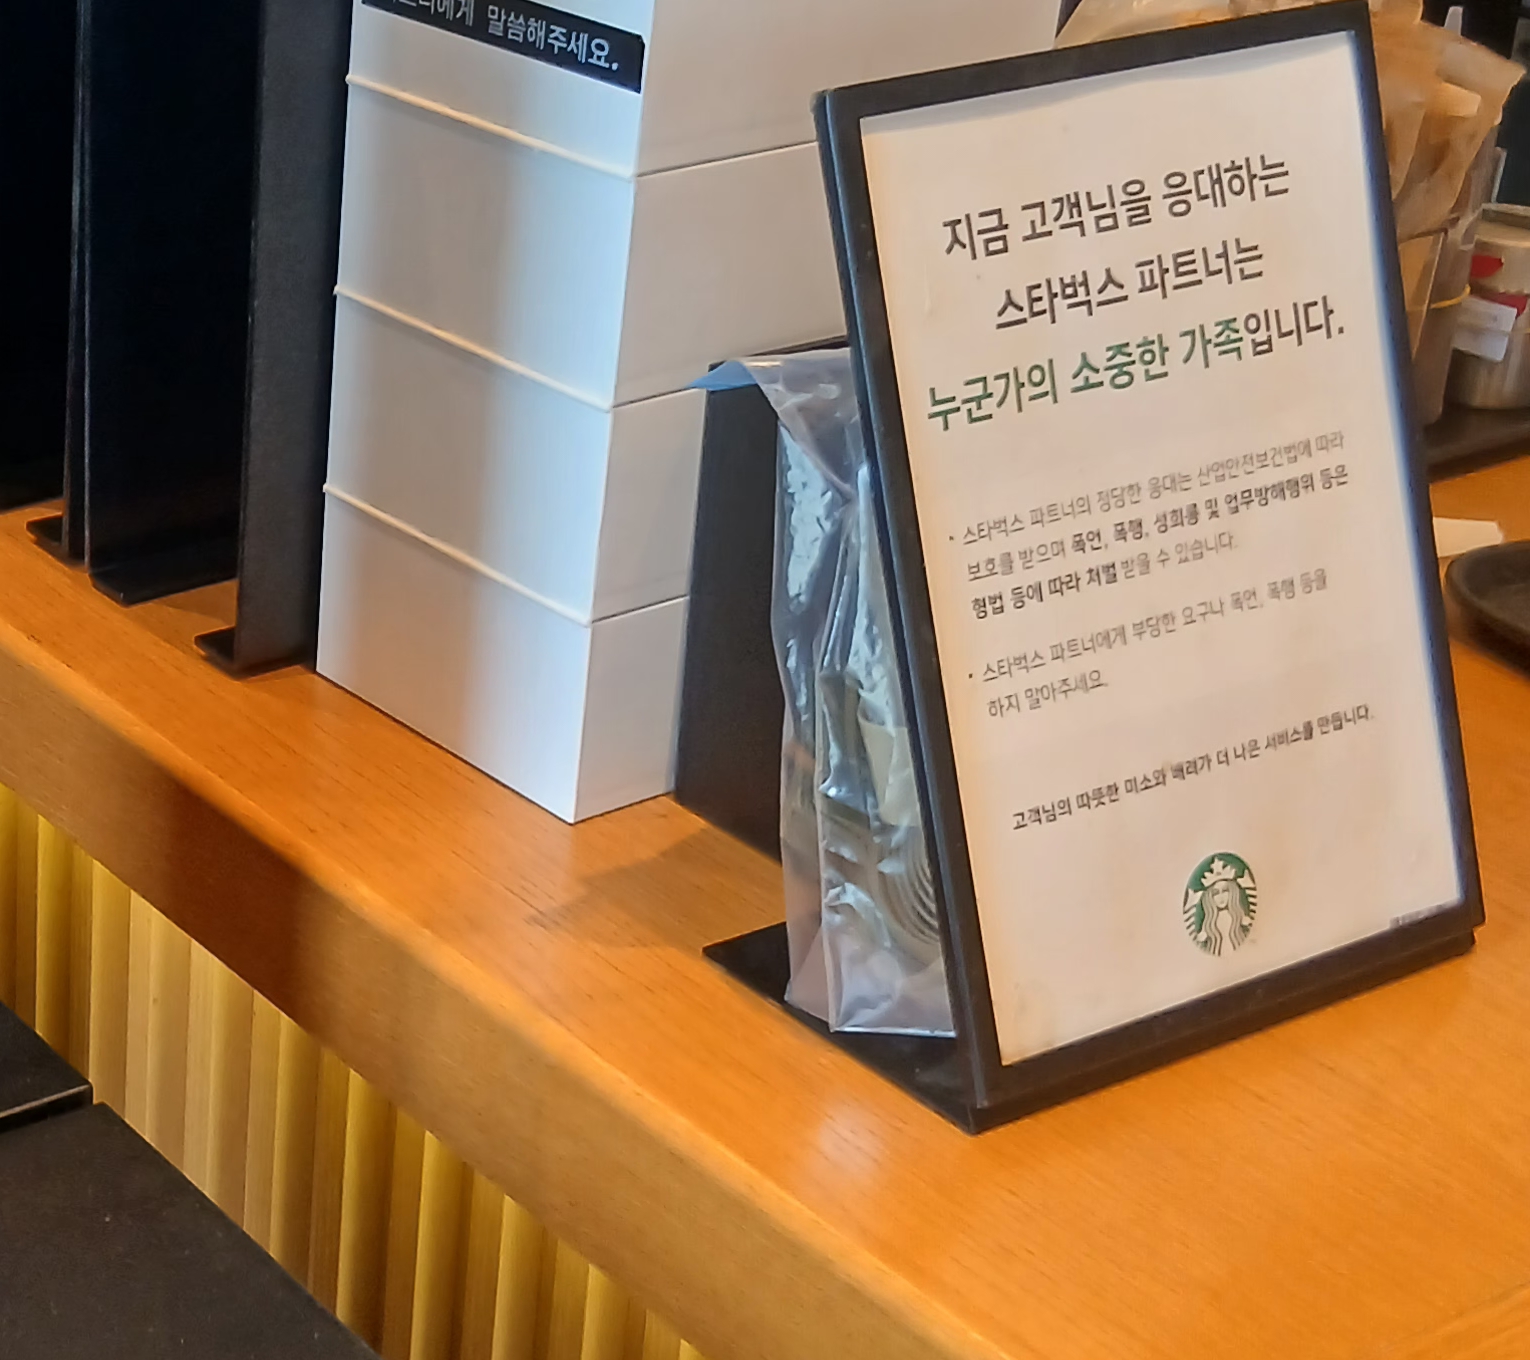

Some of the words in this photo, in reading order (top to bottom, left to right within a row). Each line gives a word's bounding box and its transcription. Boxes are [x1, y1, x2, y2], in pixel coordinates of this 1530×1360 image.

[487, 4, 620, 72] 말씀해주세요.
[942, 207, 1011, 261] 지금
[1020, 177, 1153, 244] 고객님을
[1162, 153, 1291, 218] 응대하는
[995, 265, 1129, 331] 스타벅스
[1135, 237, 1265, 301] 파트너는
[927, 357, 1058, 431] 누군가의
[1070, 335, 1171, 394] 소중한
[1179, 295, 1345, 370] 가족입니다.
[962, 512, 1025, 546] 스타벅스
[1028, 495, 1093, 529] 파트너의
[1096, 480, 1143, 513] 정당한
[1147, 469, 1193, 502] 응대는
[1197, 437, 1313, 487] 산업안전보건법에
[1315, 430, 1345, 454] 따라
[967, 551, 1015, 583] 보호를
[1018, 537, 1068, 571] 받으며
[1153, 502, 1201, 535] 성희롱
[1205, 495, 1222, 521] 및
[1223, 470, 1316, 517] 업무방해행위
[1319, 462, 1350, 491] 등은
[970, 591, 1006, 622] 형법
[1010, 580, 1045, 611] 등에
[1048, 571, 1082, 598] 따라
[1085, 561, 1118, 588] 처벌
[1120, 550, 1152, 580] 받을
[1156, 546, 1171, 570] 수
[981, 648, 1047, 684] 스타벅스
[1049, 626, 1128, 663] 파트너에게
[1131, 612, 1178, 643] 부당한
[1181, 598, 1225, 627] 요구나
[1299, 567, 1328, 594] 등을
[986, 691, 1021, 721] 하지
[1011, 796, 1074, 831] 고객님의
[1076, 782, 1120, 811] 따뜻한
[1124, 767, 1168, 795] 미소와
[1170, 755, 1212, 782] 배려가
[1216, 749, 1230, 768] 더
[1233, 738, 1261, 761] 나은
[1264, 719, 1314, 751] 서비스를
